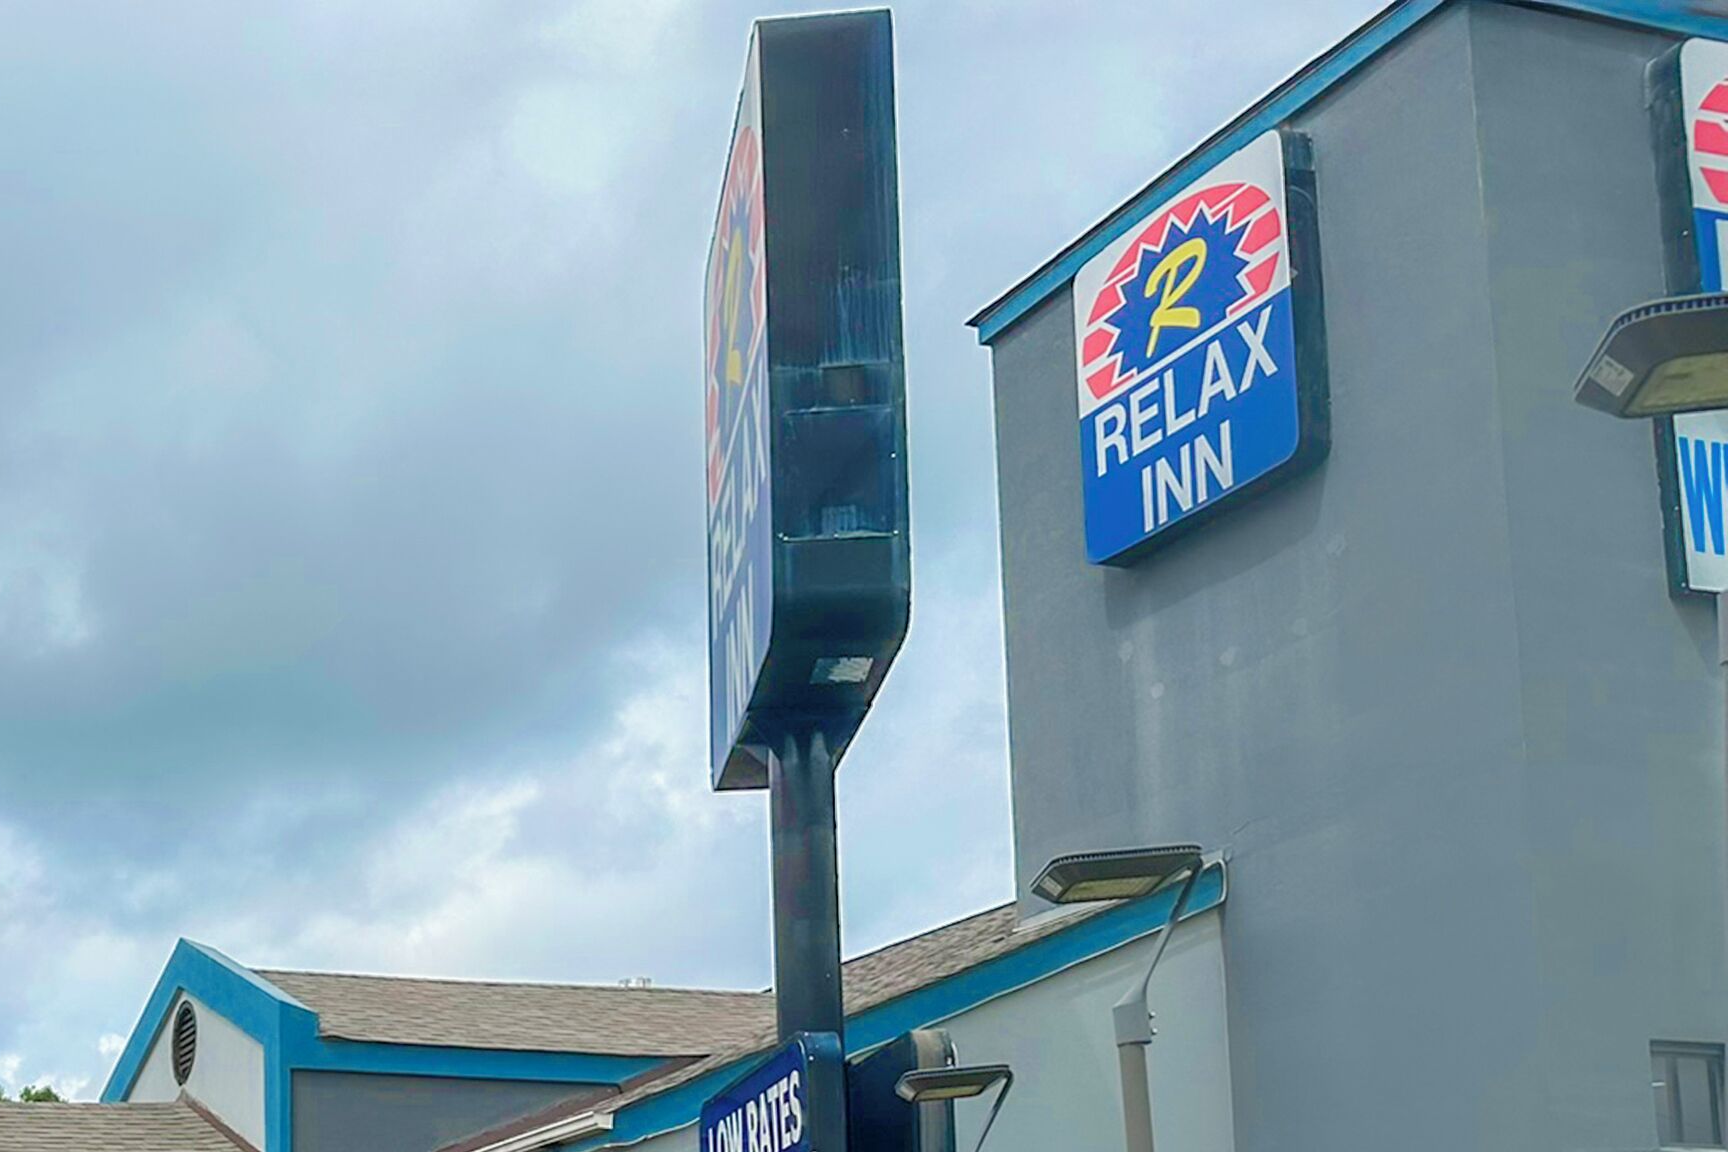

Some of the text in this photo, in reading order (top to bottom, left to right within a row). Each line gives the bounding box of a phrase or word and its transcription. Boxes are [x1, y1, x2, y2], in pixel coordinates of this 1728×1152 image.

[1144, 237, 1207, 359] R
[1094, 304, 1278, 477] RELAX
[712, 355, 766, 641] RELAX
[1141, 419, 1234, 533] INN
[1678, 436, 1728, 556] W
[726, 562, 754, 746] INN
